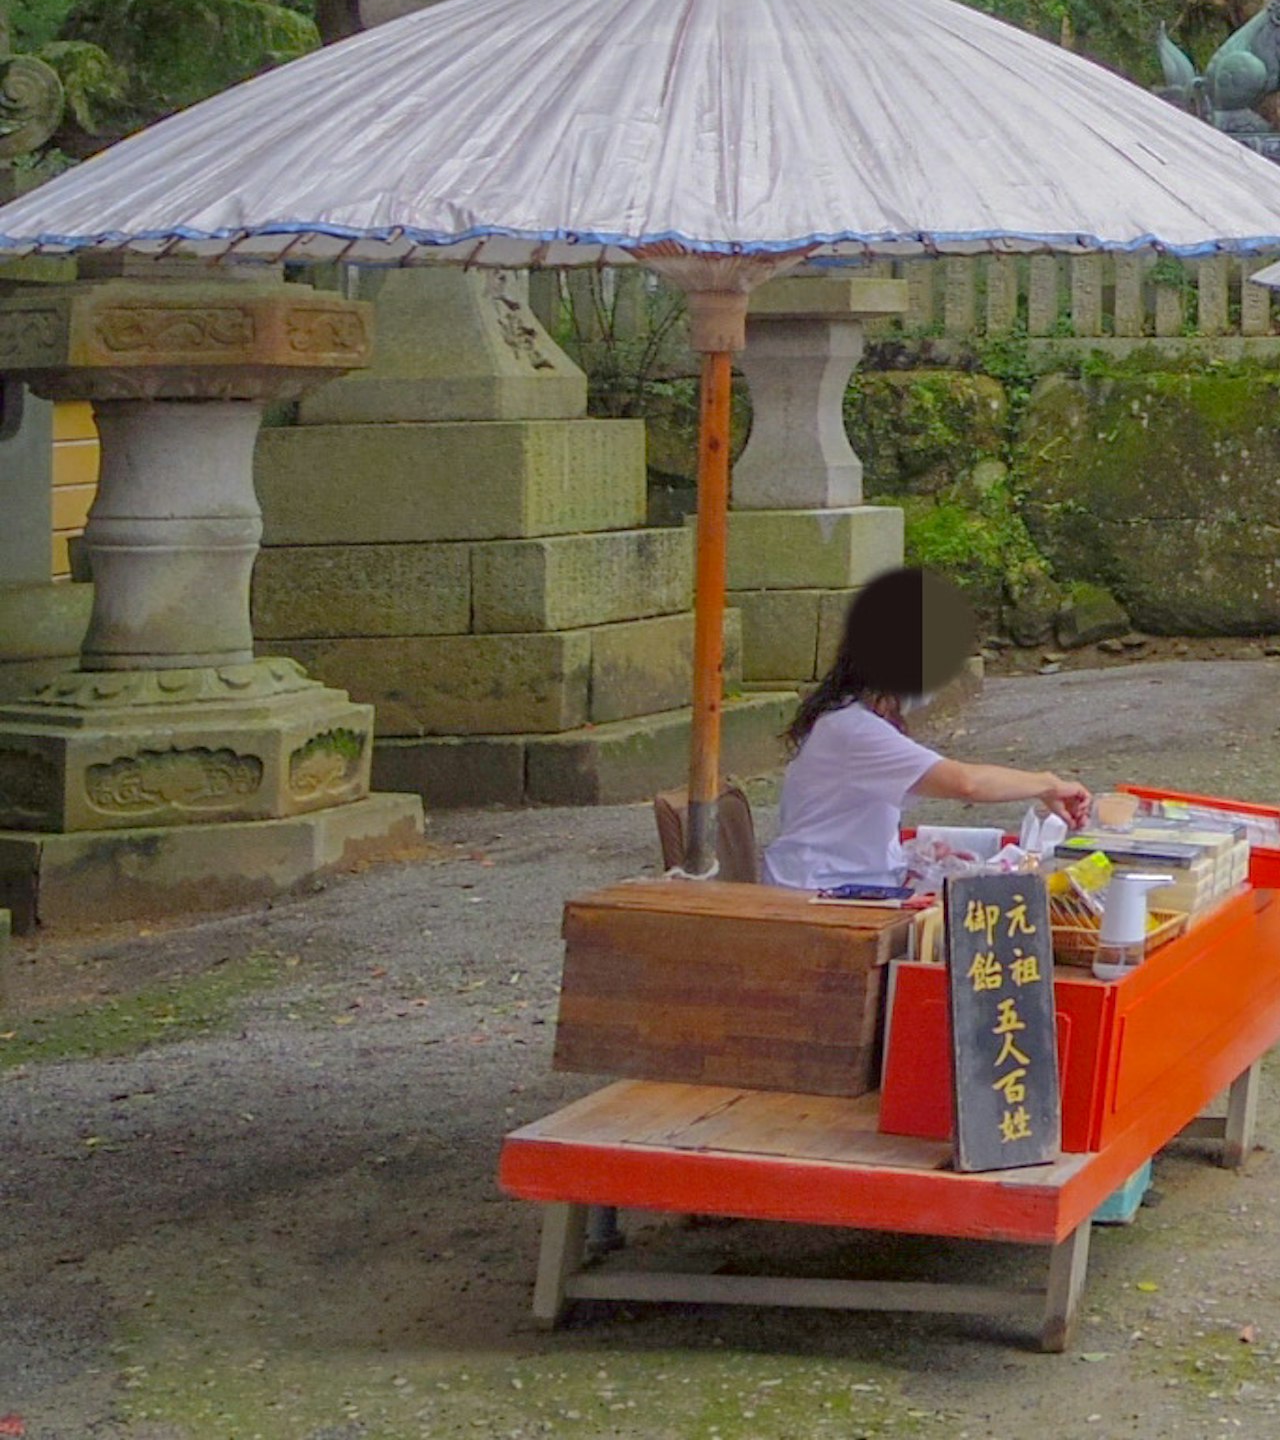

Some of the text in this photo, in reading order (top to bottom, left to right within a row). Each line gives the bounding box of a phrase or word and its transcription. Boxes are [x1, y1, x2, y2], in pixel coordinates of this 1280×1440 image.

[963, 899, 1003, 991] 御飴
[1005, 894, 1041, 987] 元祖
[992, 998, 1033, 1144] 五人百姓
